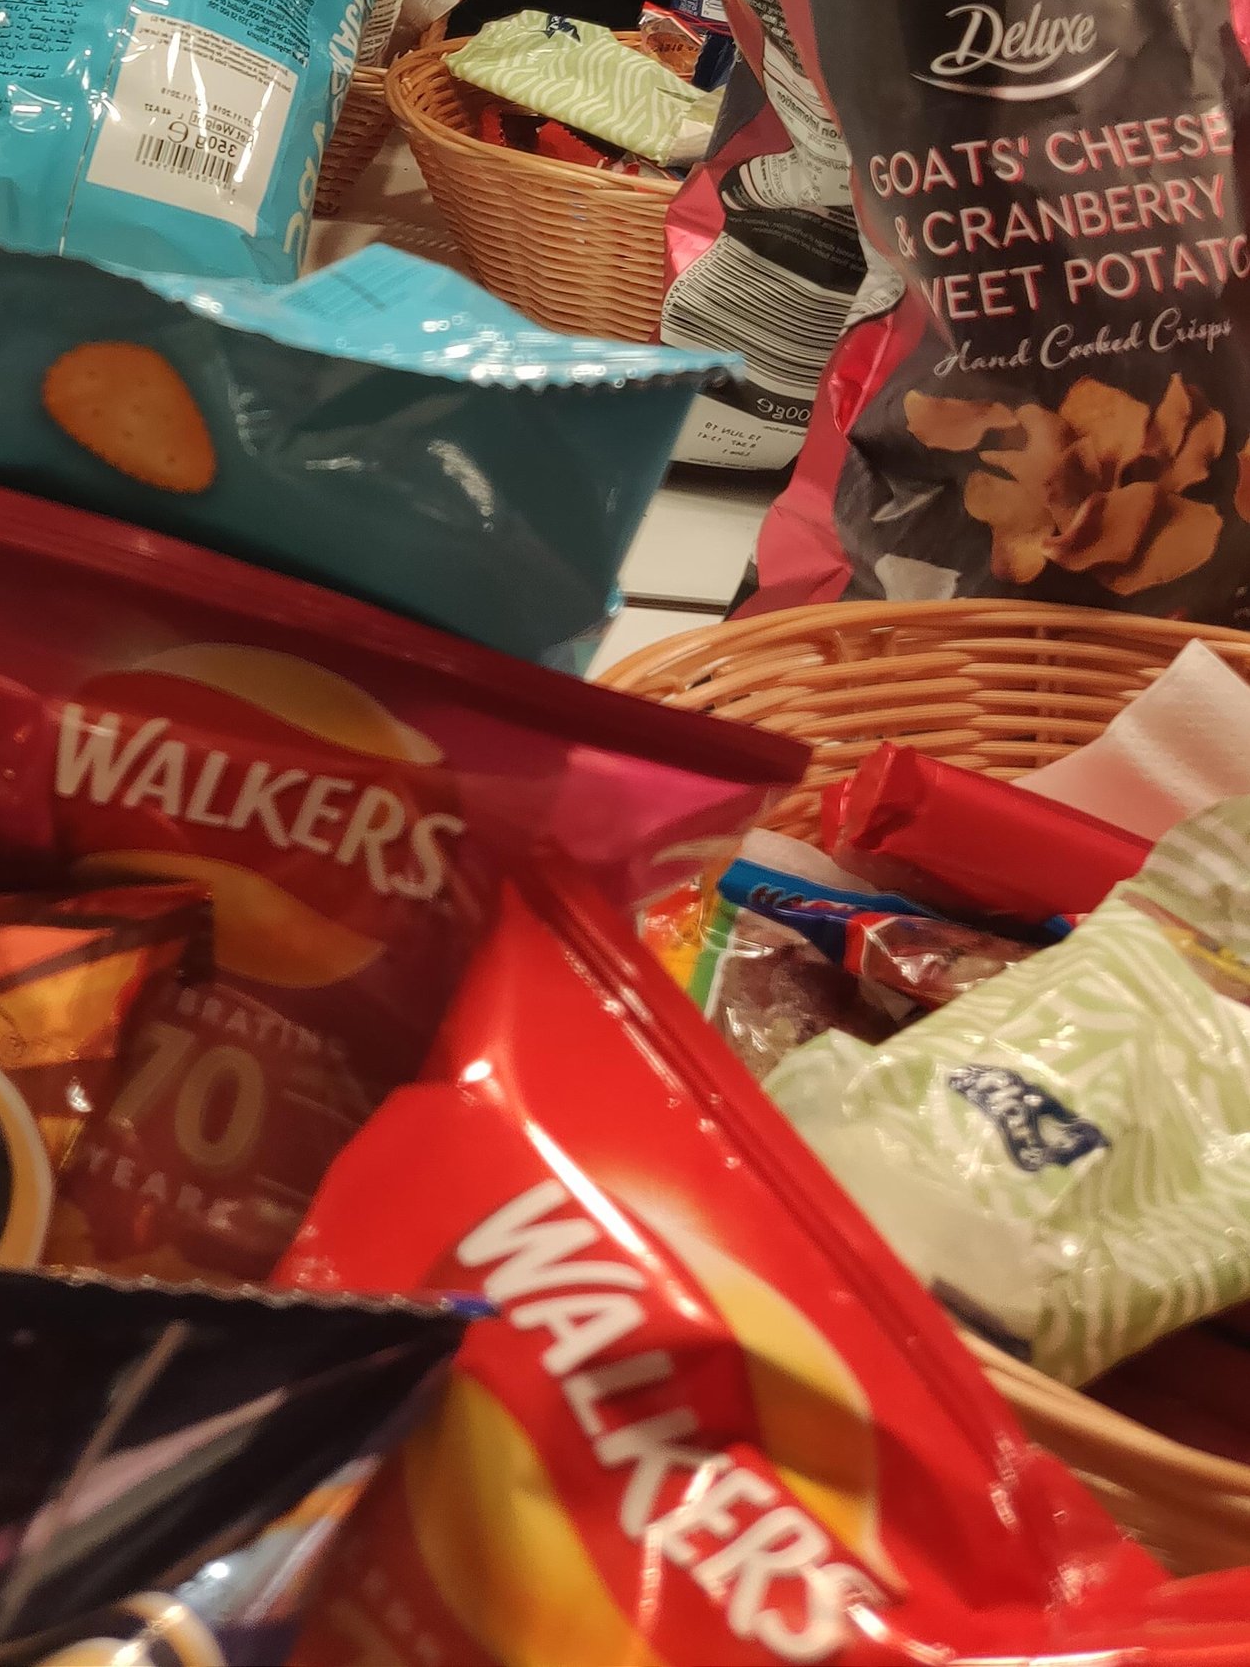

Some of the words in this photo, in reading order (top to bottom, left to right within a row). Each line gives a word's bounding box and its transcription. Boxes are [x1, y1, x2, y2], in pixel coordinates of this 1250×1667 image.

[929, 1, 1098, 76] Deluxe
[868, 134, 1030, 200] GOATS'
[1044, 110, 1234, 176] CHEESE
[893, 215, 919, 261] &
[921, 172, 1226, 258] CRANBERRY
[919, 263, 1046, 321] WEET
[1063, 234, 1250, 305] POTATO
[933, 339, 1032, 377] Hand
[1039, 322, 1144, 370] Cooked
[1149, 306, 1232, 353] Crisps
[53, 702, 467, 900] WALKERS
[107, 1020, 266, 1169] 70
[455, 1177, 889, 1665] WALKERS
